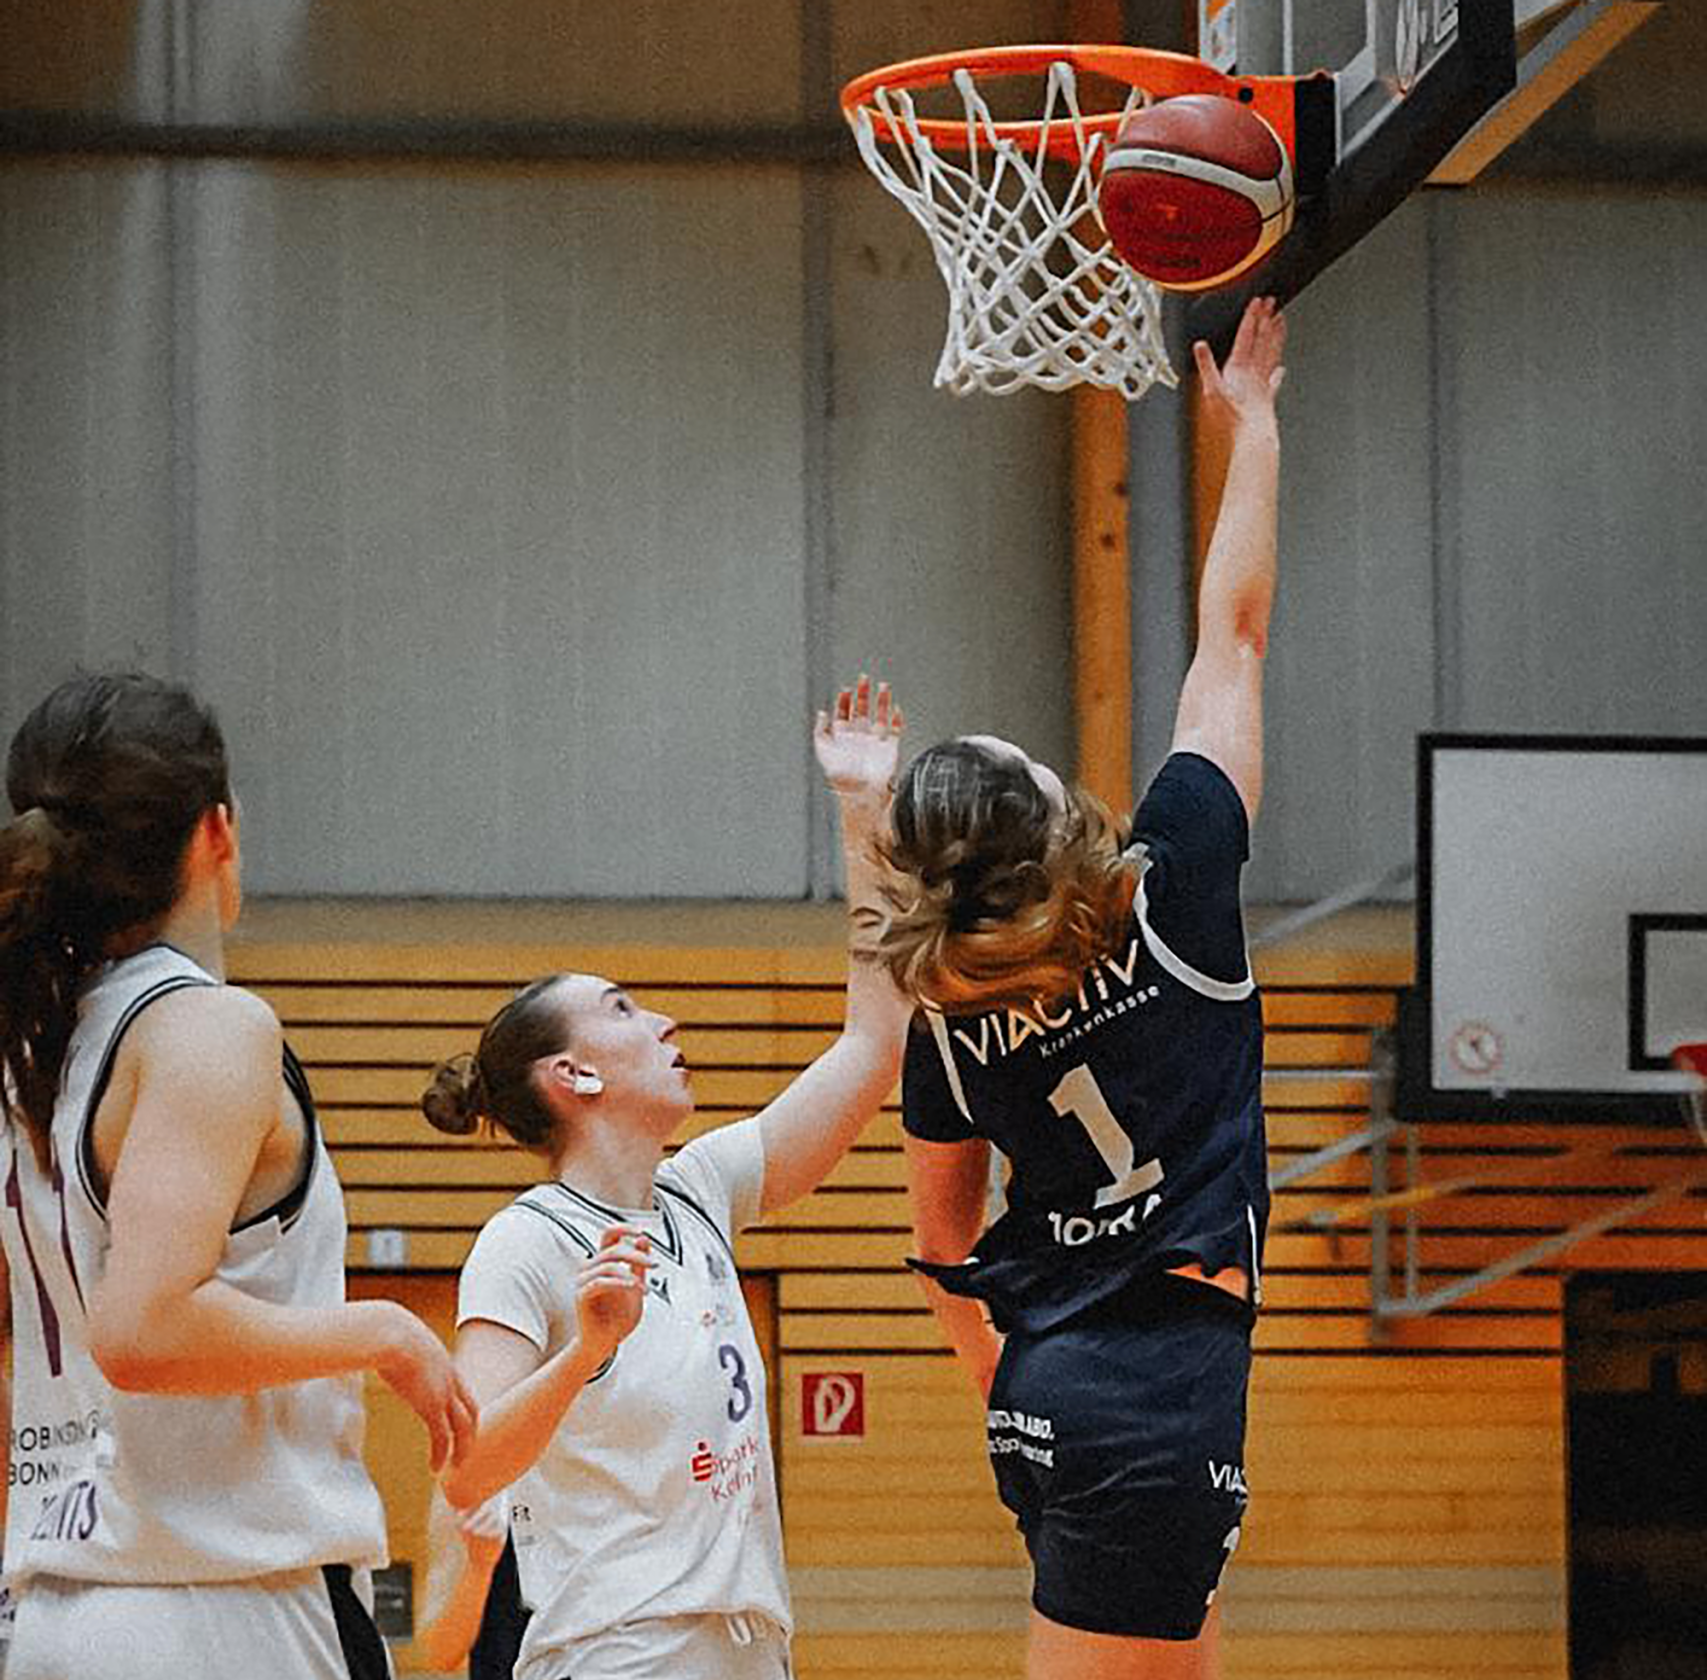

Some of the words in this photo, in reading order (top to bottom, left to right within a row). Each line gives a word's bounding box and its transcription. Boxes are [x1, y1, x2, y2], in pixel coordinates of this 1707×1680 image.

[1047, 1062, 1165, 1210] 1
[718, 1344, 752, 1423] 3
[1208, 1460, 1249, 1493] VIA
